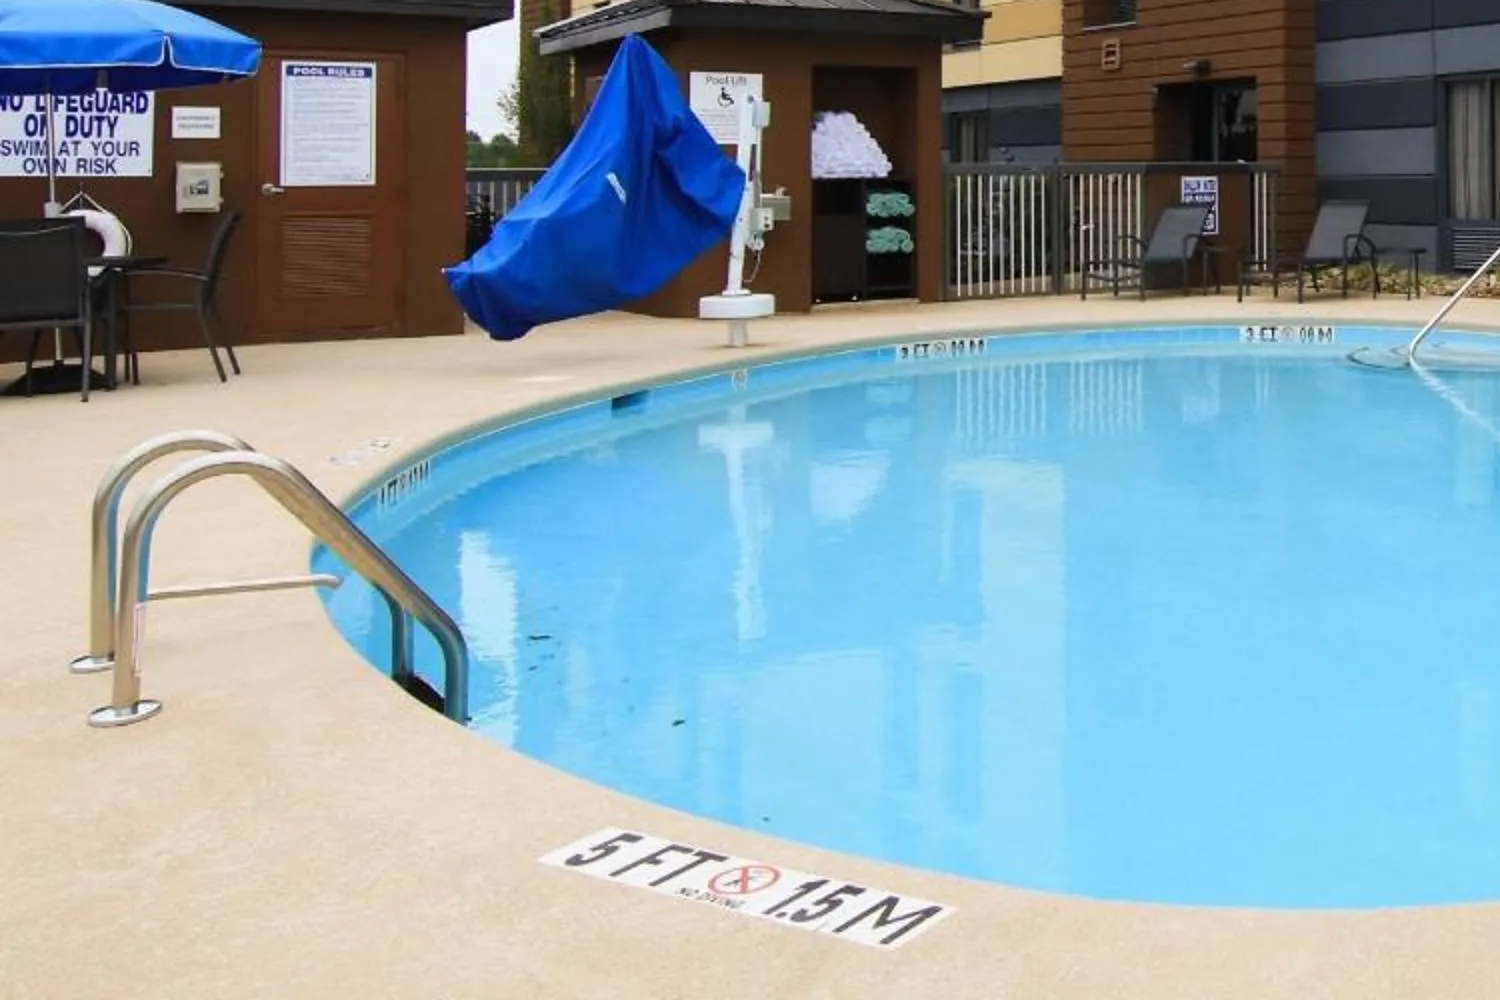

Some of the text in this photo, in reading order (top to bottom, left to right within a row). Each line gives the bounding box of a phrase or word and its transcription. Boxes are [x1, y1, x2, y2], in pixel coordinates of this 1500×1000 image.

[35, 89, 149, 114] LFEGUARD
[65, 115, 119, 138] DUTY
[0, 139, 141, 157] SWIM AT YOUR
[23, 157, 117, 174] OWN RISK
[564, 833, 646, 868] 5
[608, 843, 730, 887] FT
[762, 879, 868, 923] 1.5
[833, 895, 943, 946] M
